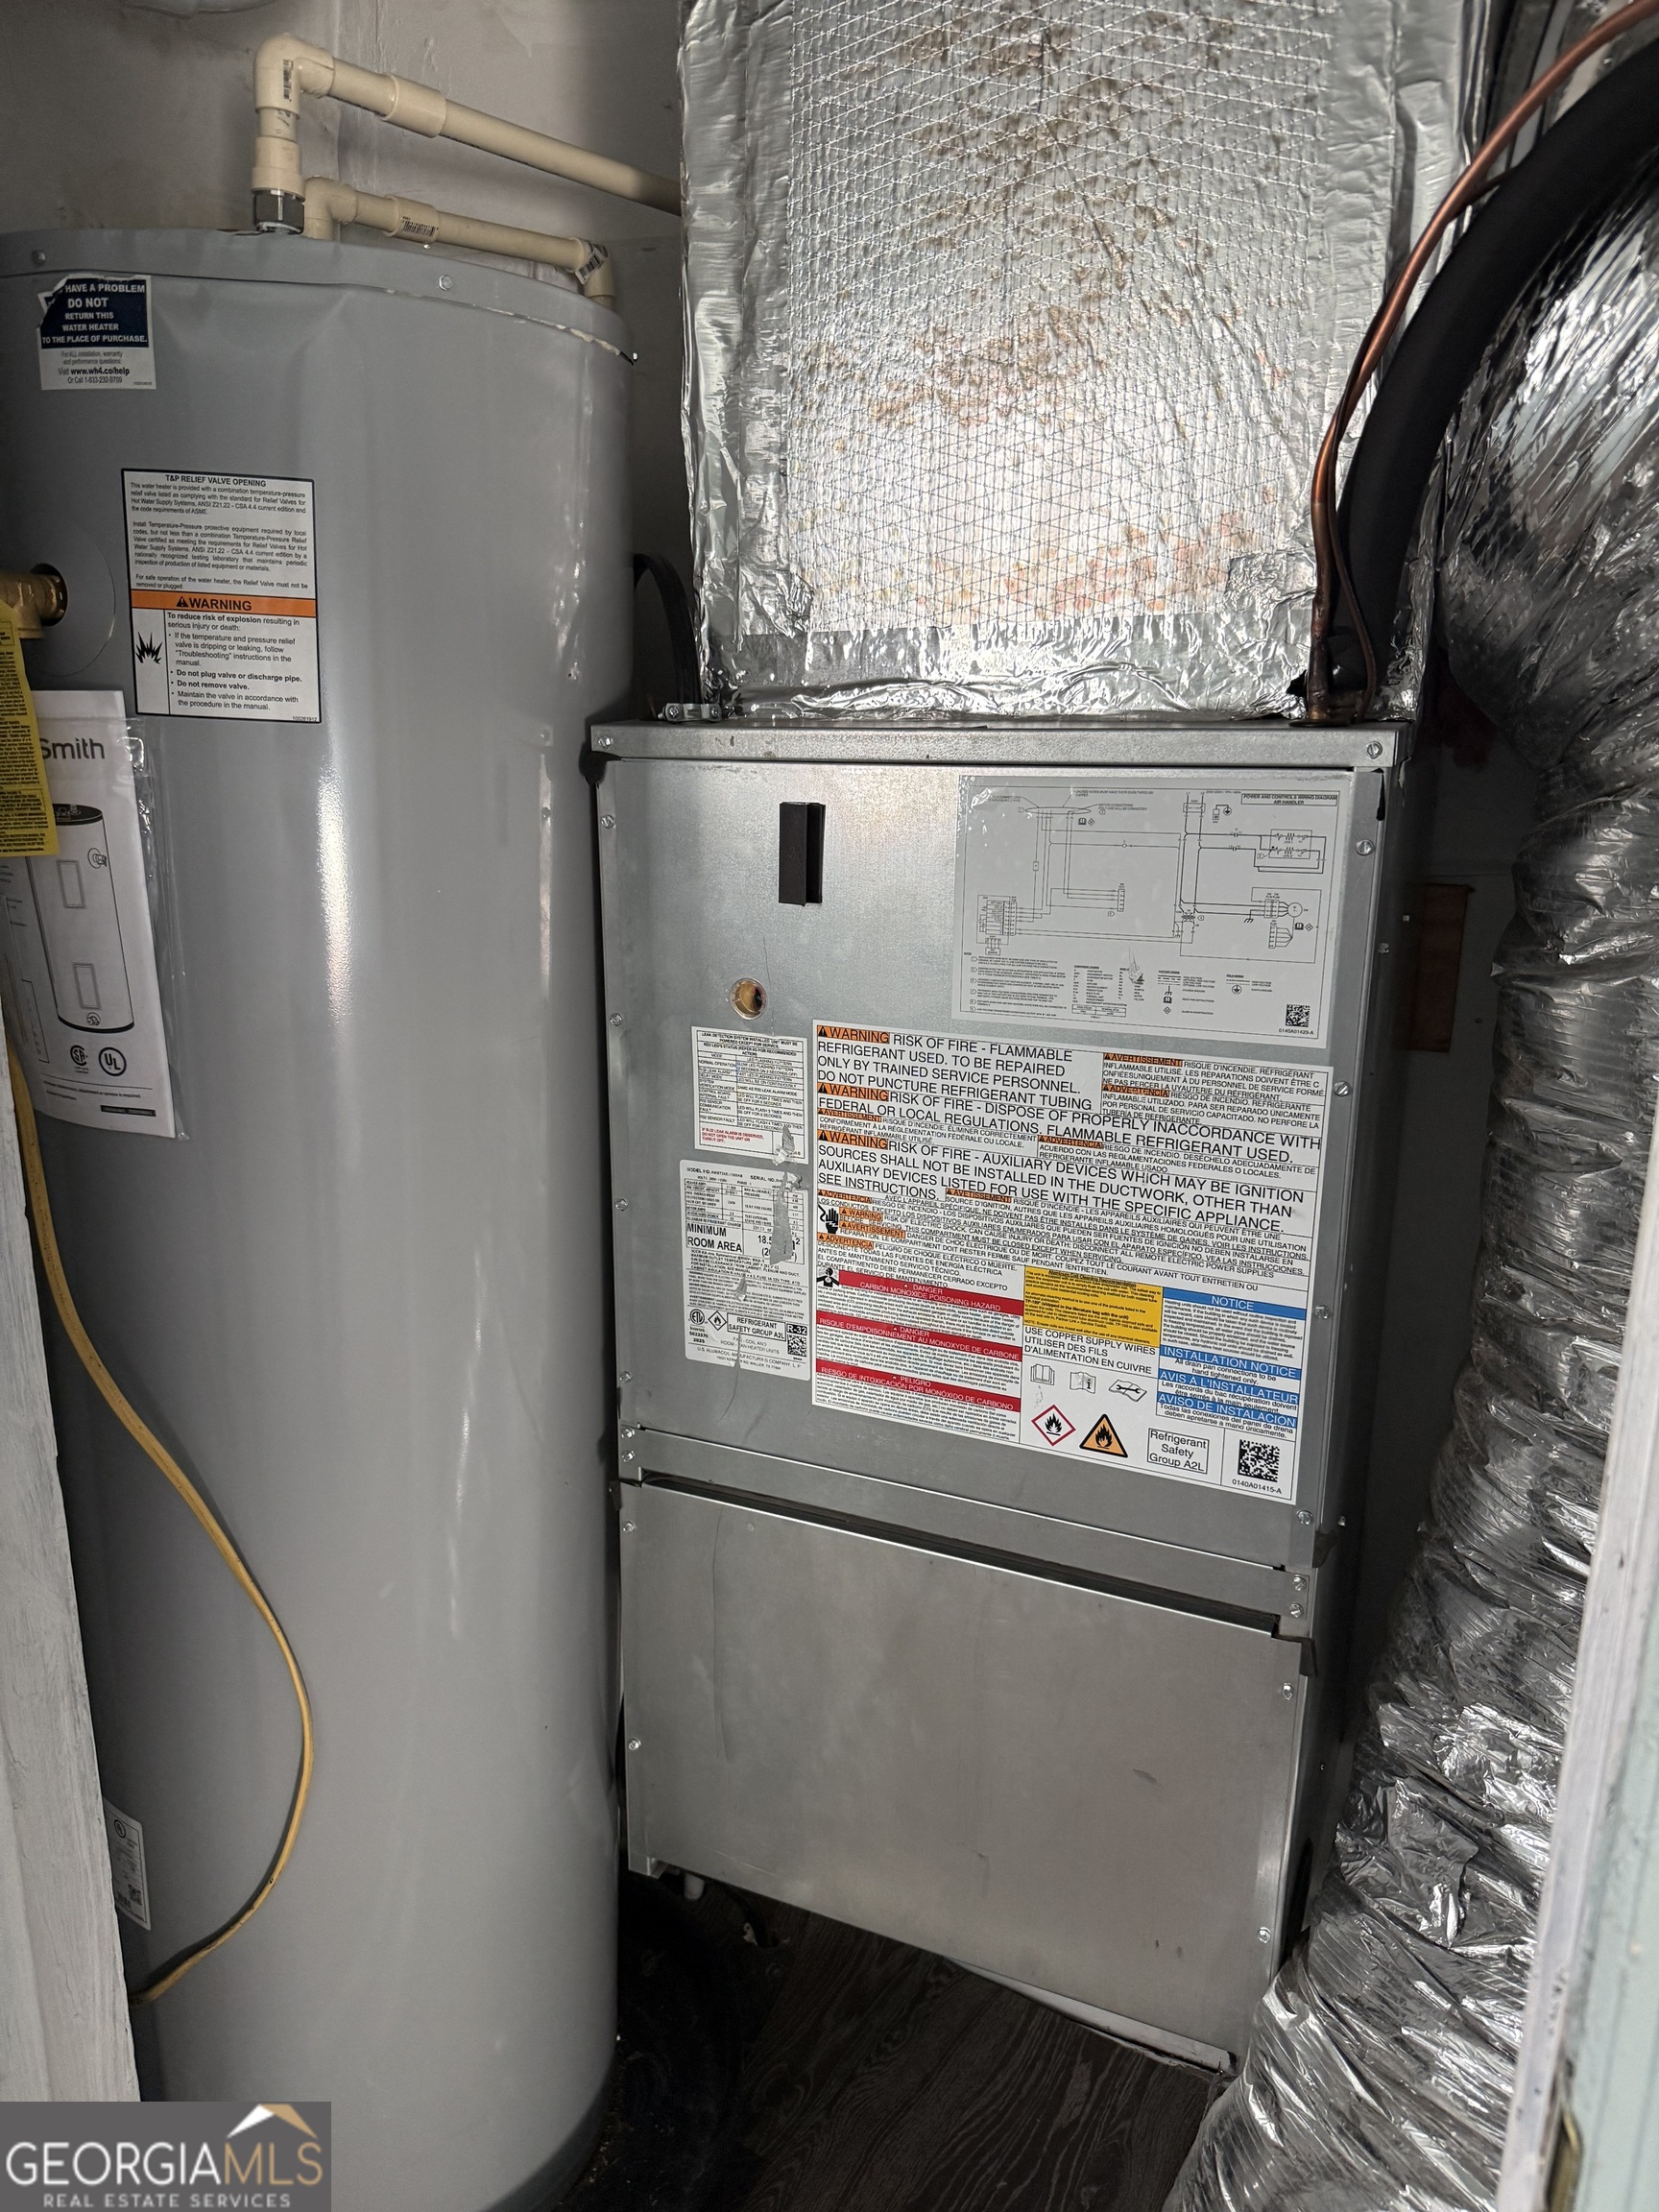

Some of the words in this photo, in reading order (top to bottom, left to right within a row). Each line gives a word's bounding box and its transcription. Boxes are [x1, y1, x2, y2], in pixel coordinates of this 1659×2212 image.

[65, 284, 86, 293] HAVE
[89, 284, 96, 293] A
[98, 284, 145, 293] PROBLEM
[67, 298, 83, 308] DO
[85, 298, 109, 307] NOT
[188, 598, 252, 611] WARNING
[227, 615, 261, 624] explosion
[247, 673, 282, 682] discharge
[42, 738, 105, 759] Smith
[830, 1027, 889, 1044] WARNING
[894, 1034, 922, 1047] RISK
[926, 1037, 944, 1049] OF
[949, 1039, 976, 1053] FIRE
[990, 1043, 1071, 1062] FLAMMABLE
[818, 1042, 906, 1060] REFRIGERANT
[909, 1050, 947, 1065] USED.
[951, 1055, 970, 1067] TO
[974, 1057, 991, 1069] BE
[996, 1059, 1065, 1076] REPAIRED
[817, 1056, 851, 1070] ONLY
[854, 1060, 870, 1071] BY
[873, 1062, 928, 1077] TRAINED
[932, 1068, 988, 1084] SERVICE
[993, 1074, 1079, 1094] PERSONNEL.
[817, 1070, 835, 1082] DO
[839, 1072, 864, 1086] NOT
[868, 1076, 936, 1094] PUNCTURE
[941, 1083, 1037, 1104] REFRIGERANT
[830, 1084, 888, 1100] WARNING
[819, 1097, 874, 1114] FEDERAL
[878, 1104, 895, 1117] OR
[899, 1107, 939, 1121] LOCAL
[945, 1112, 1042, 1134] REGULATIONS.
[1046, 1124, 1131, 1144] FLAMMABLE
[1137, 1135, 1242, 1157] REFRIGERANT
[1247, 1147, 1293, 1163] USED.
[891, 1092, 919, 1105] RISK
[923, 1095, 939, 1108] OF
[944, 1097, 973, 1112] FIRE
[985, 1102, 1044, 1119] DISPOSE
[1048, 1109, 1067, 1121] OF
[1072, 1112, 1148, 1131] PROPERLY
[1154, 1120, 1274, 1144] INACCORDANCE
[1280, 1134, 1321, 1150] WITH
[830, 1132, 887, 1149] WARNING
[818, 1145, 876, 1163] SOURCES
[880, 1153, 919, 1168] SHALL
[923, 1159, 950, 1172] NOT
[953, 1163, 970, 1175] BE
[974, 1166, 1046, 1186] INSTALLED
[1050, 1175, 1063, 1188] IN
[1068, 1178, 1094, 1191] THE
[1099, 1182, 1187, 1204] DUCTWORK,
[1192, 1194, 1244, 1212] OTHER
[1250, 1201, 1291, 1217] THAN
[889, 1142, 918, 1155] RISK
[921, 1145, 937, 1157] OF
[942, 1147, 970, 1162] FIRE
[982, 1152, 1051, 1171] AUXILIARY
[1056, 1162, 1116, 1179] DEVICES
[1120, 1169, 1169, 1186] WHICH
[1174, 1176, 1206, 1190] MAY
[1211, 1180, 1229, 1193] BE
[1236, 1184, 1303, 1203] IGNITION
[817, 1173, 841, 1186] SEE
[845, 1177, 938, 1200] INSTRUCTIONS.
[818, 1159, 881, 1178] AUXILIARY
[883, 1167, 936, 1186] DEVICES
[941, 1175, 985, 1192] LISTED
[990, 1182, 1017, 1196] FOR
[1022, 1187, 1047, 1200] USE
[1052, 1190, 1088, 1206] WITH
[1093, 1196, 1119, 1210] THE
[1124, 1200, 1190, 1219] SPECIFIC
[1194, 1210, 1283, 1232] APPLIANCE.
[686, 1224, 727, 1237] MINIMUM
[688, 1238, 713, 1250] ROOM
[716, 1239, 743, 1253] AREA
[1153, 1269, 1177, 1280] AVANT
[1181, 1273, 1200, 1283] TOUT
[1202, 1276, 1244, 1289] ENTRETIEN
[1246, 1283, 1258, 1291] OU
[860, 1283, 889, 1293] CARBON
[890, 1287, 926, 1299] MONOXIDE
[929, 1293, 969, 1306] POISONING
[971, 1300, 1000, 1310] HAZARD
[913, 1285, 942, 1294] DANGER
[1212, 1296, 1253, 1310] NOTICE
[728, 1324, 751, 1334] SAFETY
[752, 1328, 772, 1336] GROUP
[736, 1317, 777, 1329] REFRIGERANT
[787, 1325, 807, 1334] R-32
[1024, 1335, 1065, 1351] UTILISER
[1067, 1342, 1085, 1354] DES
[1089, 1346, 1107, 1358] FILS
[1025, 1327, 1043, 1337] USE
[1045, 1330, 1083, 1344] COPPER
[1086, 1336, 1121, 1350] SUPPLY
[1124, 1342, 1155, 1356] WIRES
[1024, 1345, 1098, 1366] D'ALIMENTATION
[1101, 1358, 1114, 1368] EN
[1117, 1359, 1150, 1374] CUIVRE
[1165, 1347, 1246, 1369] INSTALLATION
[1251, 1361, 1295, 1377] NOTICE
[1160, 1371, 1187, 1384] AVIS
[1200, 1378, 1298, 1404] L'INSTALLATEUR
[1158, 1394, 1194, 1409] AVISO
[1197, 1401, 1212, 1412] DE
[1150, 1431, 1207, 1449] Refrigerant
[1162, 1444, 1193, 1458] Safety
[1149, 1454, 1181, 1468] Group
[1183, 1459, 1204, 1472] A2L
